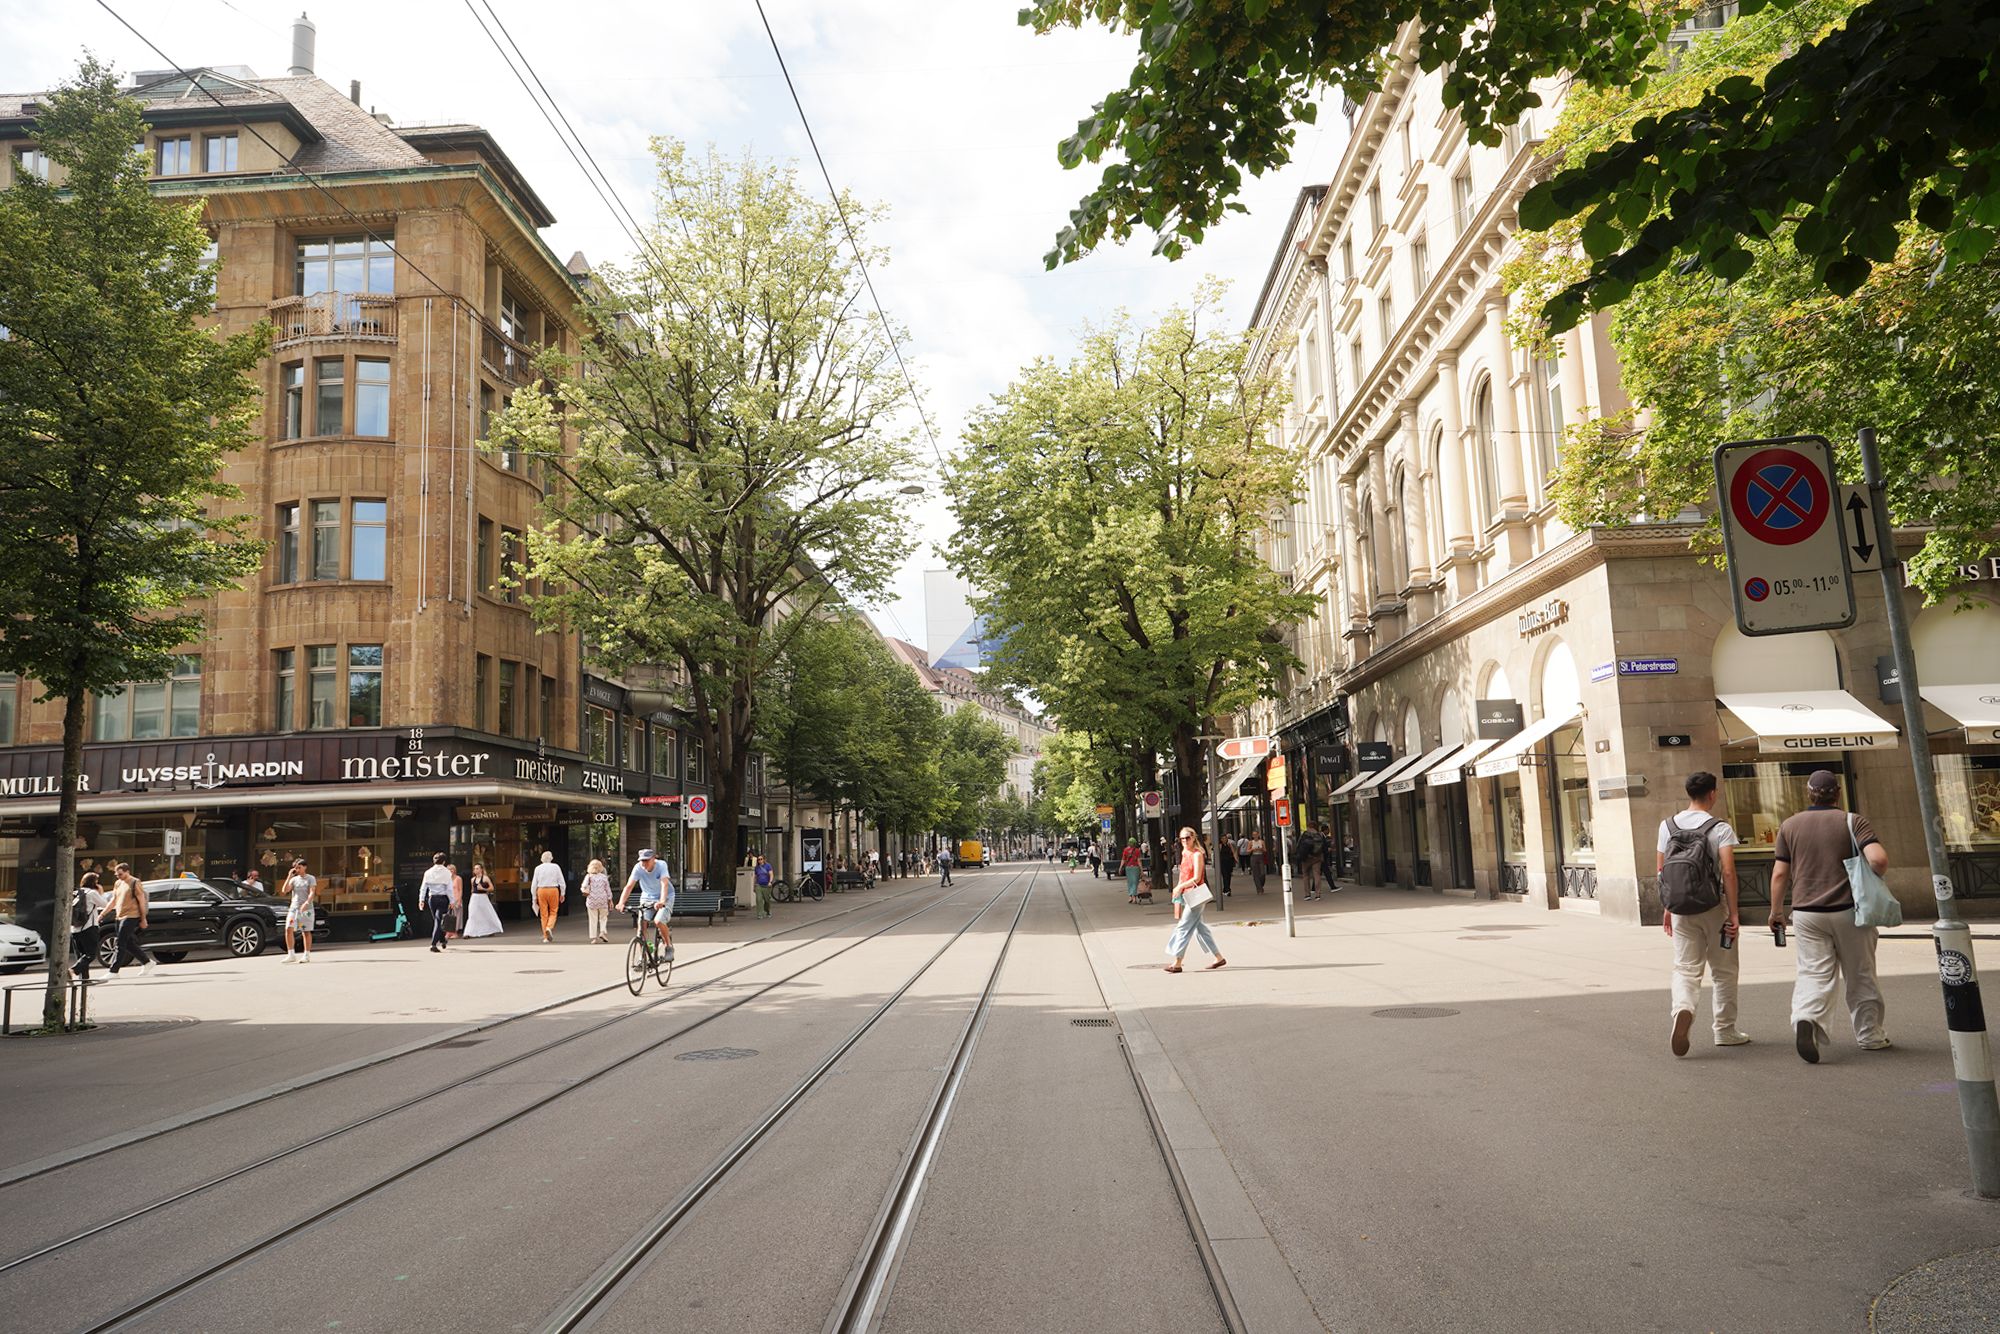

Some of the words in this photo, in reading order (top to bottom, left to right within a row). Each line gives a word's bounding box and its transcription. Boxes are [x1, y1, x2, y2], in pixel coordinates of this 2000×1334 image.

[1620, 662, 1631, 672] St.
[1631, 660, 1676, 671] Peterstrasse
[409, 728, 424, 739] 18
[408, 739, 423, 750] 81
[1784, 735, 1874, 748] GÜBELIN
[341, 750, 490, 780] meister
[515, 757, 566, 785] meister
[122, 765, 202, 783] ULYSSE
[218, 760, 304, 780] NARDIN
[0, 774, 91, 795] MULLR
[582, 770, 624, 793] ZENITH
[470, 811, 500, 820] ZENITH
[594, 813, 615, 822] OD'S
[168, 836, 181, 846] TAXI
